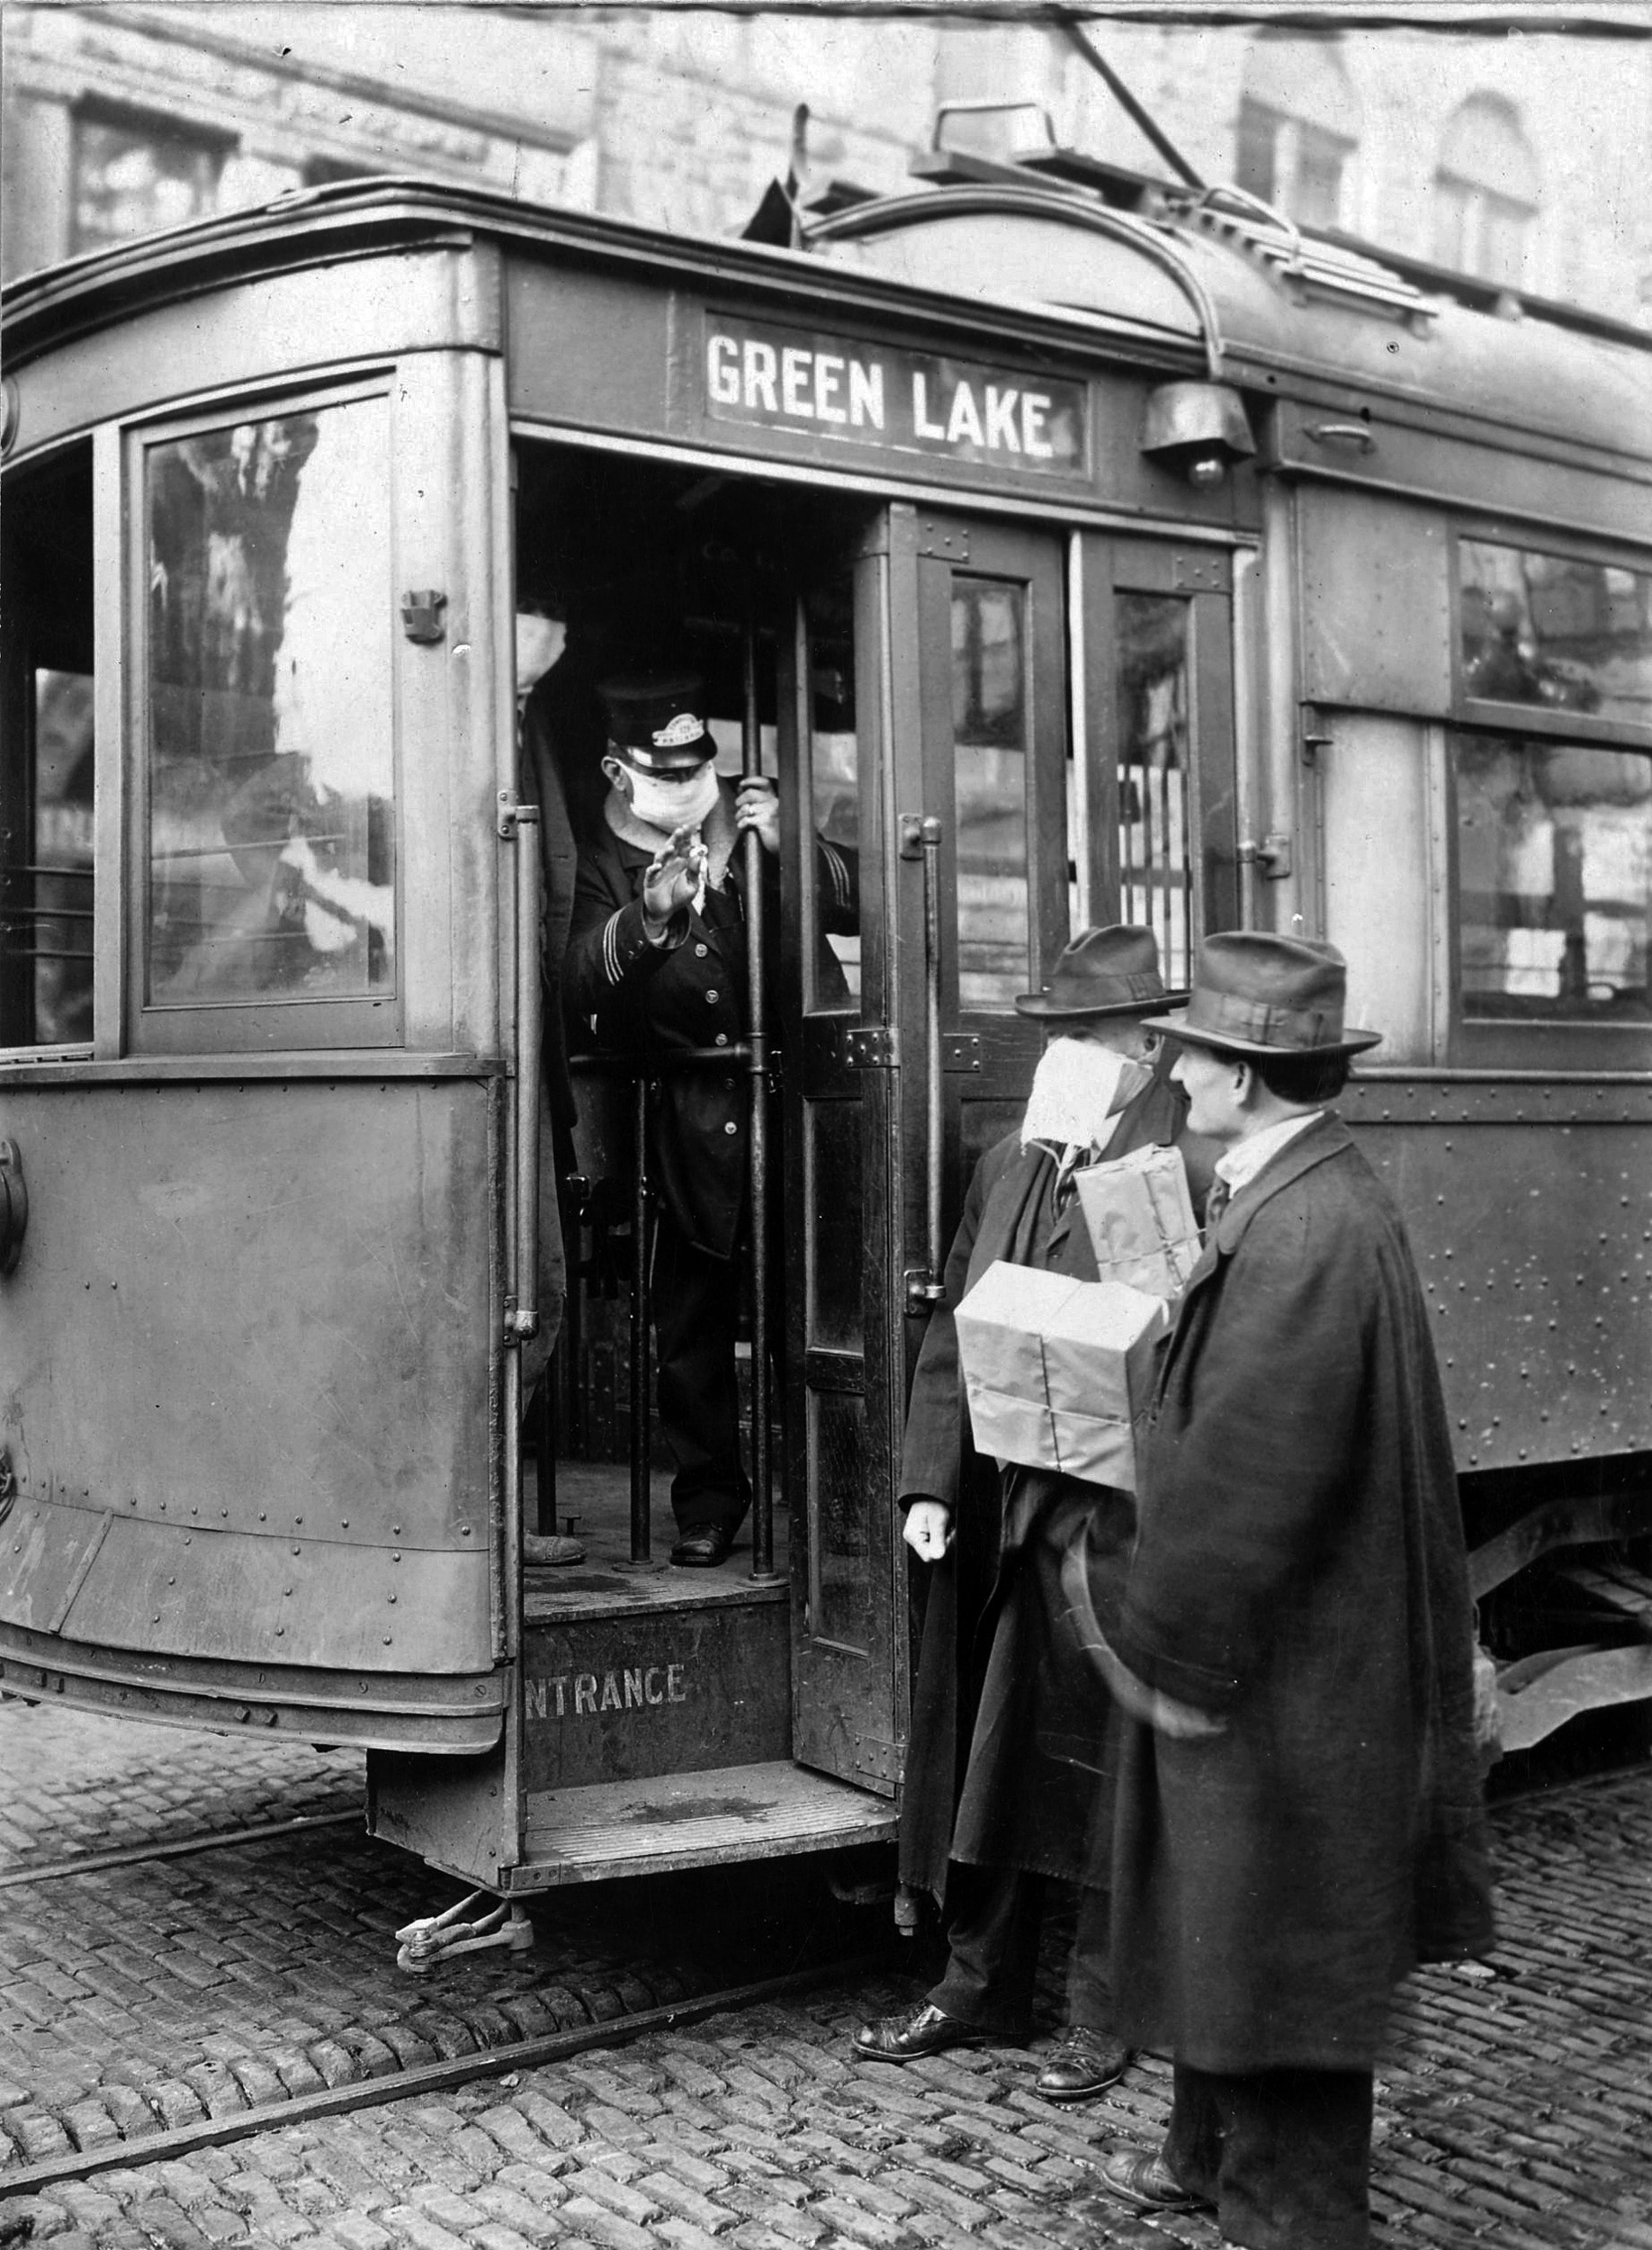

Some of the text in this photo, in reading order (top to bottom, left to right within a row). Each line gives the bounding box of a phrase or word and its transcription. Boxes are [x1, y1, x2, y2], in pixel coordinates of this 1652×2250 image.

[707, 335, 1054, 458] GREEN LAKE
[525, 1664, 687, 1720] NTRANCE
